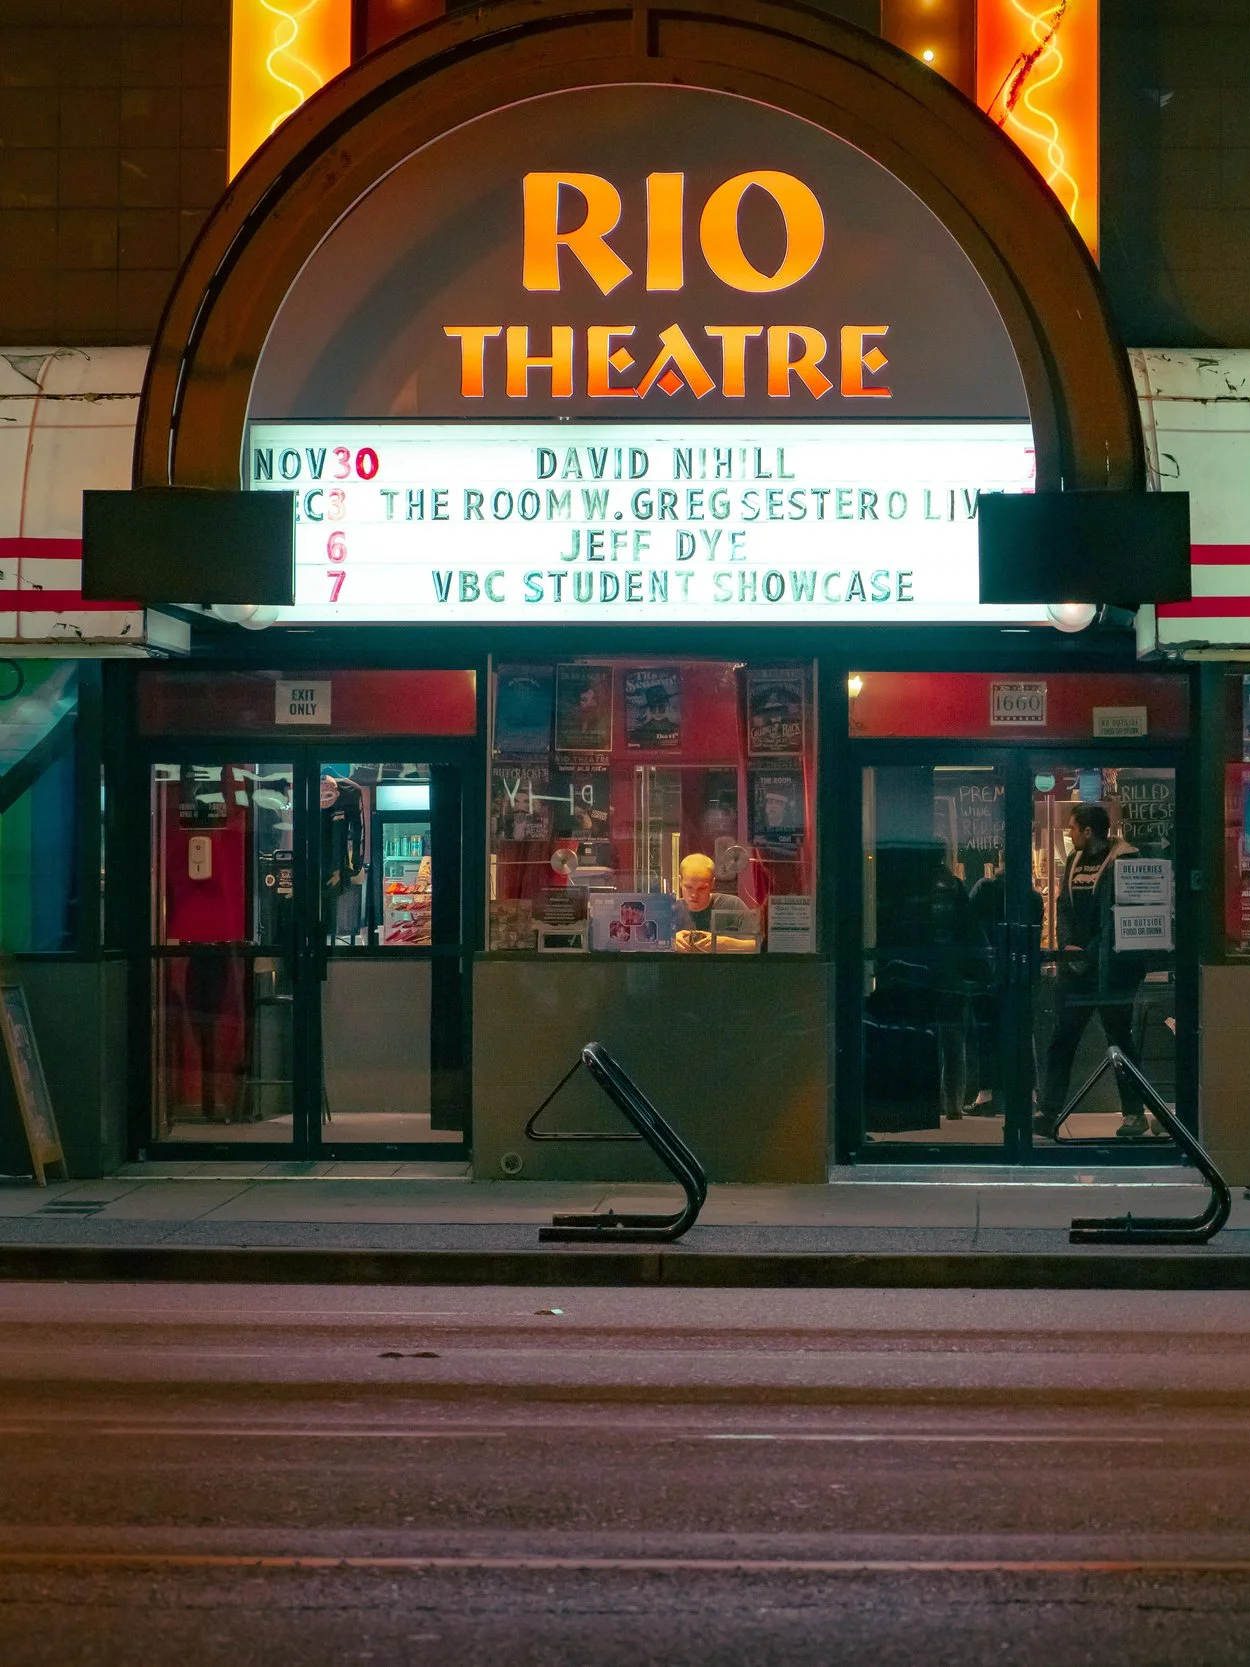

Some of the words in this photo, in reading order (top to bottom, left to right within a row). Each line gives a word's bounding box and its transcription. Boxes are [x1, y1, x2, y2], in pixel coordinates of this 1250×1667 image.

[523, 170, 826, 296] RIO
[443, 324, 894, 399] THEATRE
[537, 447, 650, 480] DAVID
[380, 488, 450, 521] THE
[326, 530, 347, 564] 6
[560, 529, 651, 562] JEFF
[675, 529, 747, 562] DYE
[326, 570, 347, 603] 7
[432, 569, 506, 603] VBC
[523, 569, 695, 603] STUDENT
[712, 569, 914, 603] SHOWCASE
[291, 689, 316, 702] EXIT
[996, 694, 1041, 712] 1660
[289, 703, 317, 716] ONLY
[1123, 865, 1163, 873] DELIVERIES
[1122, 919, 1132, 927] NO
[1133, 918, 1163, 927] OUTSIDE
[1122, 927, 1137, 936] FOOD
[1137, 927, 1146, 935] OR
[1146, 926, 1163, 935] DRINK
